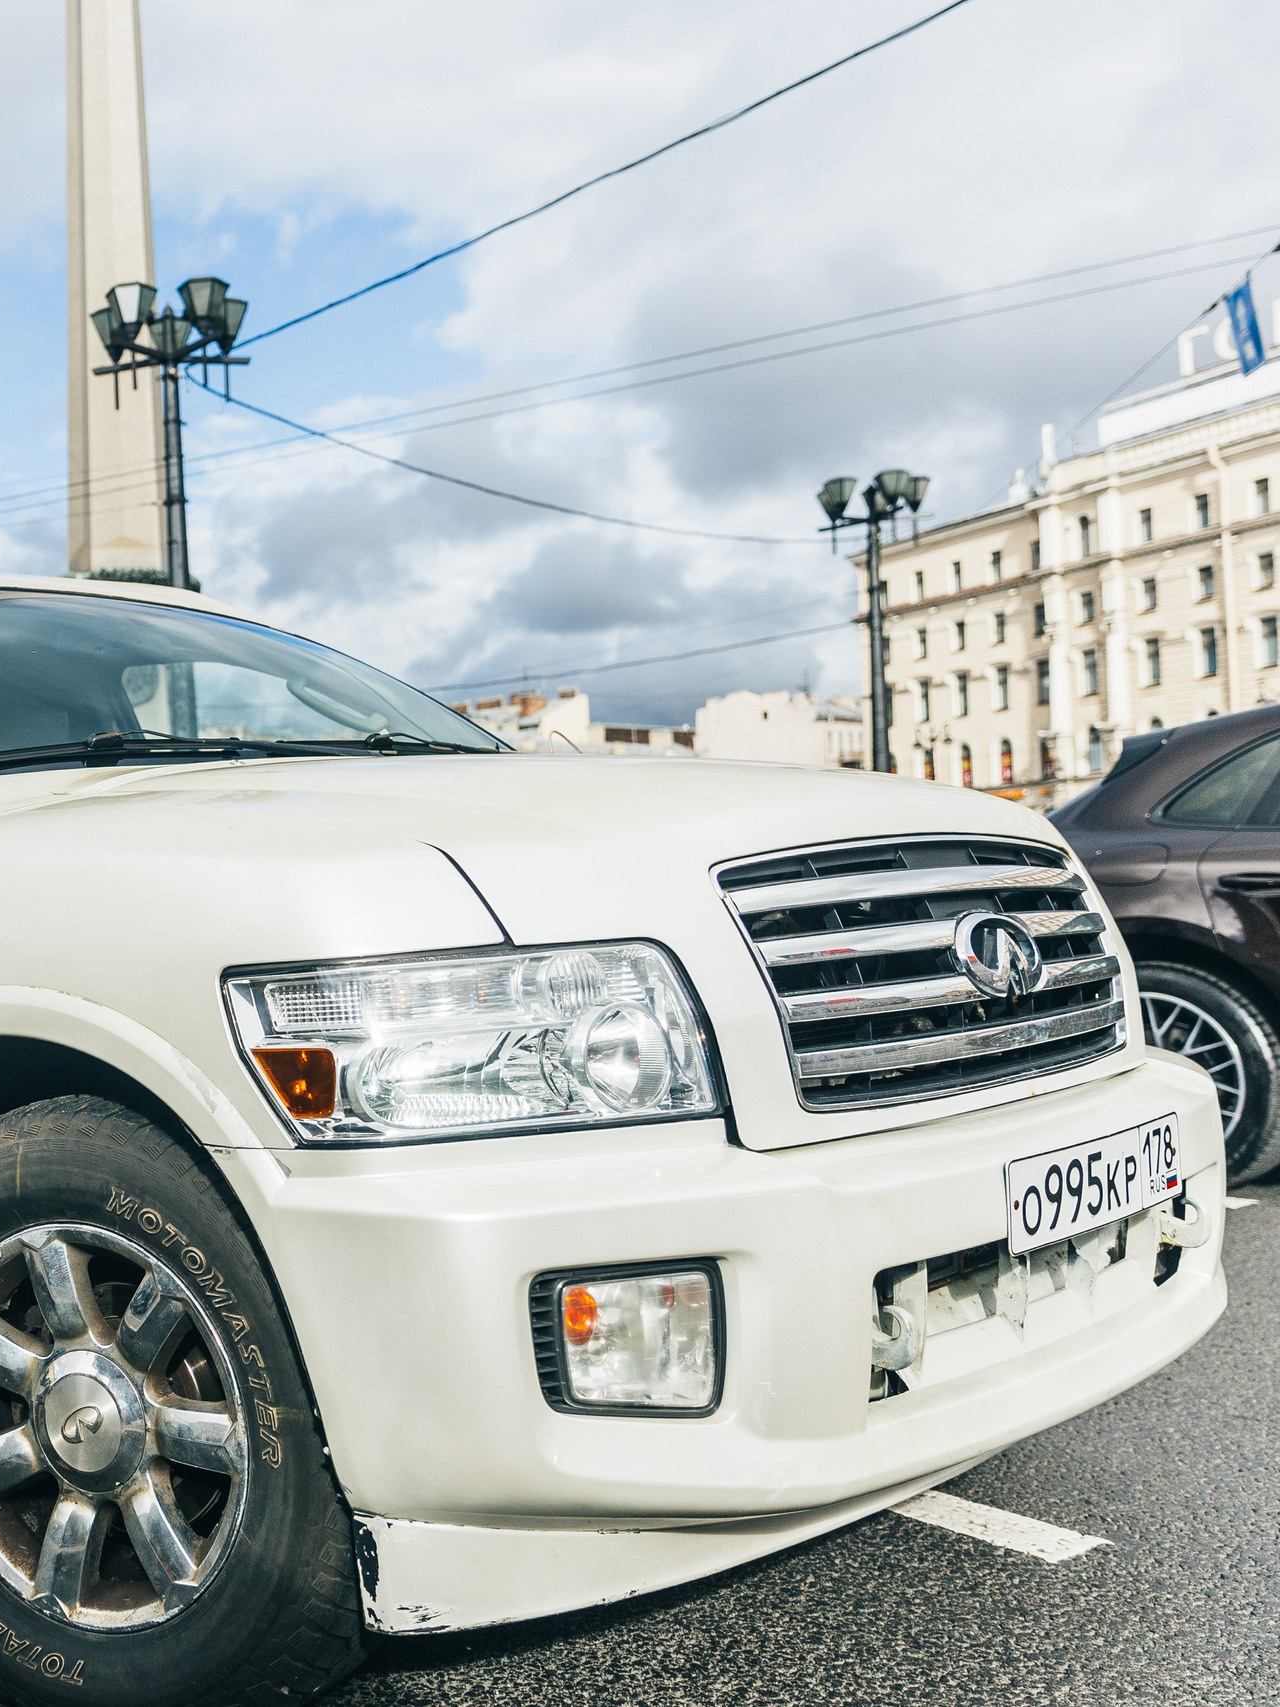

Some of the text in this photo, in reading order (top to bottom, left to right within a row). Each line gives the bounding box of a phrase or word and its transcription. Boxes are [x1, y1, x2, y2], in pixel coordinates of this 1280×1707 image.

[1142, 1124, 1173, 1177] 178
[1149, 1174, 1167, 1195] RUS
[106, 1186, 282, 1470] MOTOMASTER
